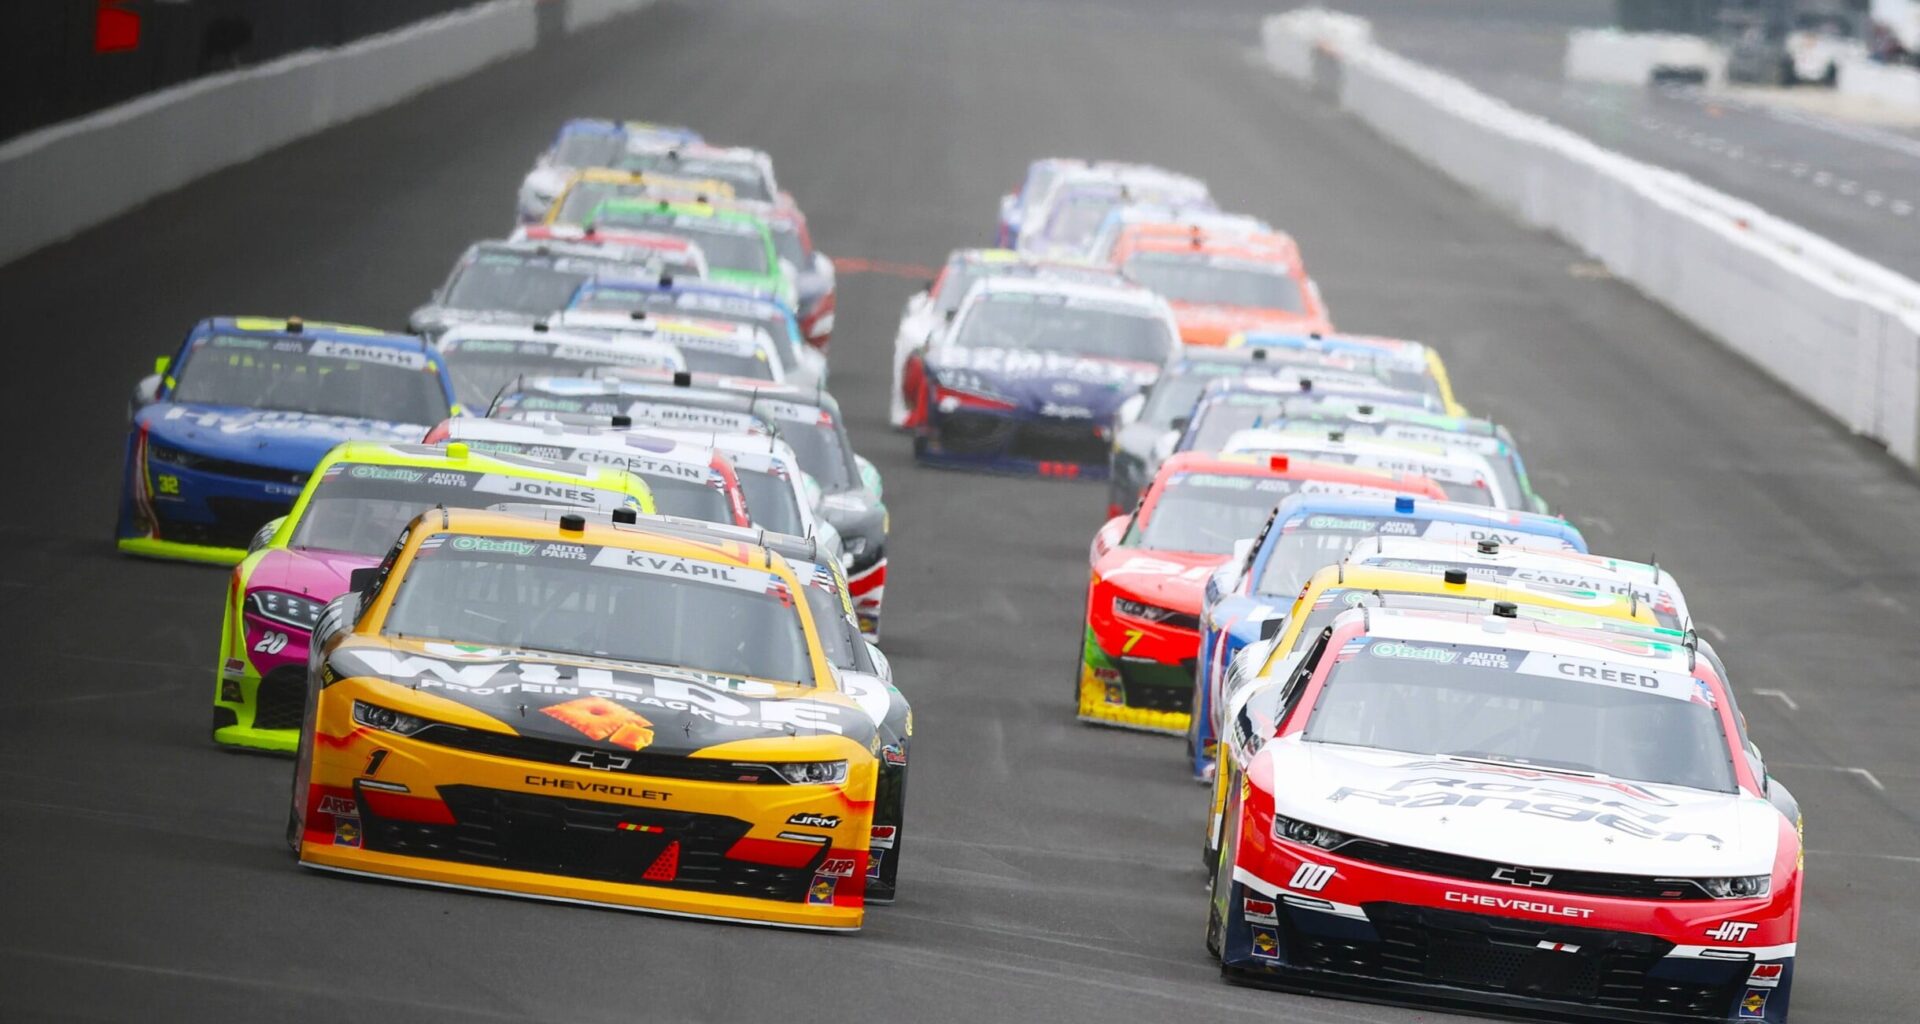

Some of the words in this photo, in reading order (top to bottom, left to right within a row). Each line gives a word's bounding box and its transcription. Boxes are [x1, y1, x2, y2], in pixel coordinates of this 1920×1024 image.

[433, 471, 466, 481] AUTO
[578, 451, 700, 480] CHASTAIN
[158, 474, 179, 494] 32
[508, 480, 597, 503] JONES
[452, 536, 539, 557] O'Reilly
[546, 543, 585, 554] AUTO
[1470, 530, 1520, 546] DAY
[541, 549, 587, 561] PARTS
[626, 554, 737, 583] KVAPIL
[254, 630, 289, 655] 20
[1122, 630, 1144, 653] 7
[1463, 657, 1509, 669] PARTS
[1468, 651, 1507, 661] AUTO
[1558, 661, 1660, 690] CREED
[421, 678, 579, 696] PROTEIN
[363, 748, 390, 777] 1
[524, 774, 673, 801] CHEVROLET
[789, 816, 840, 827] JRM
[819, 860, 854, 873] ARP
[1288, 862, 1337, 892] 00
[1445, 890, 1594, 919] CHEVROLET
[1705, 921, 1759, 942] HFT
